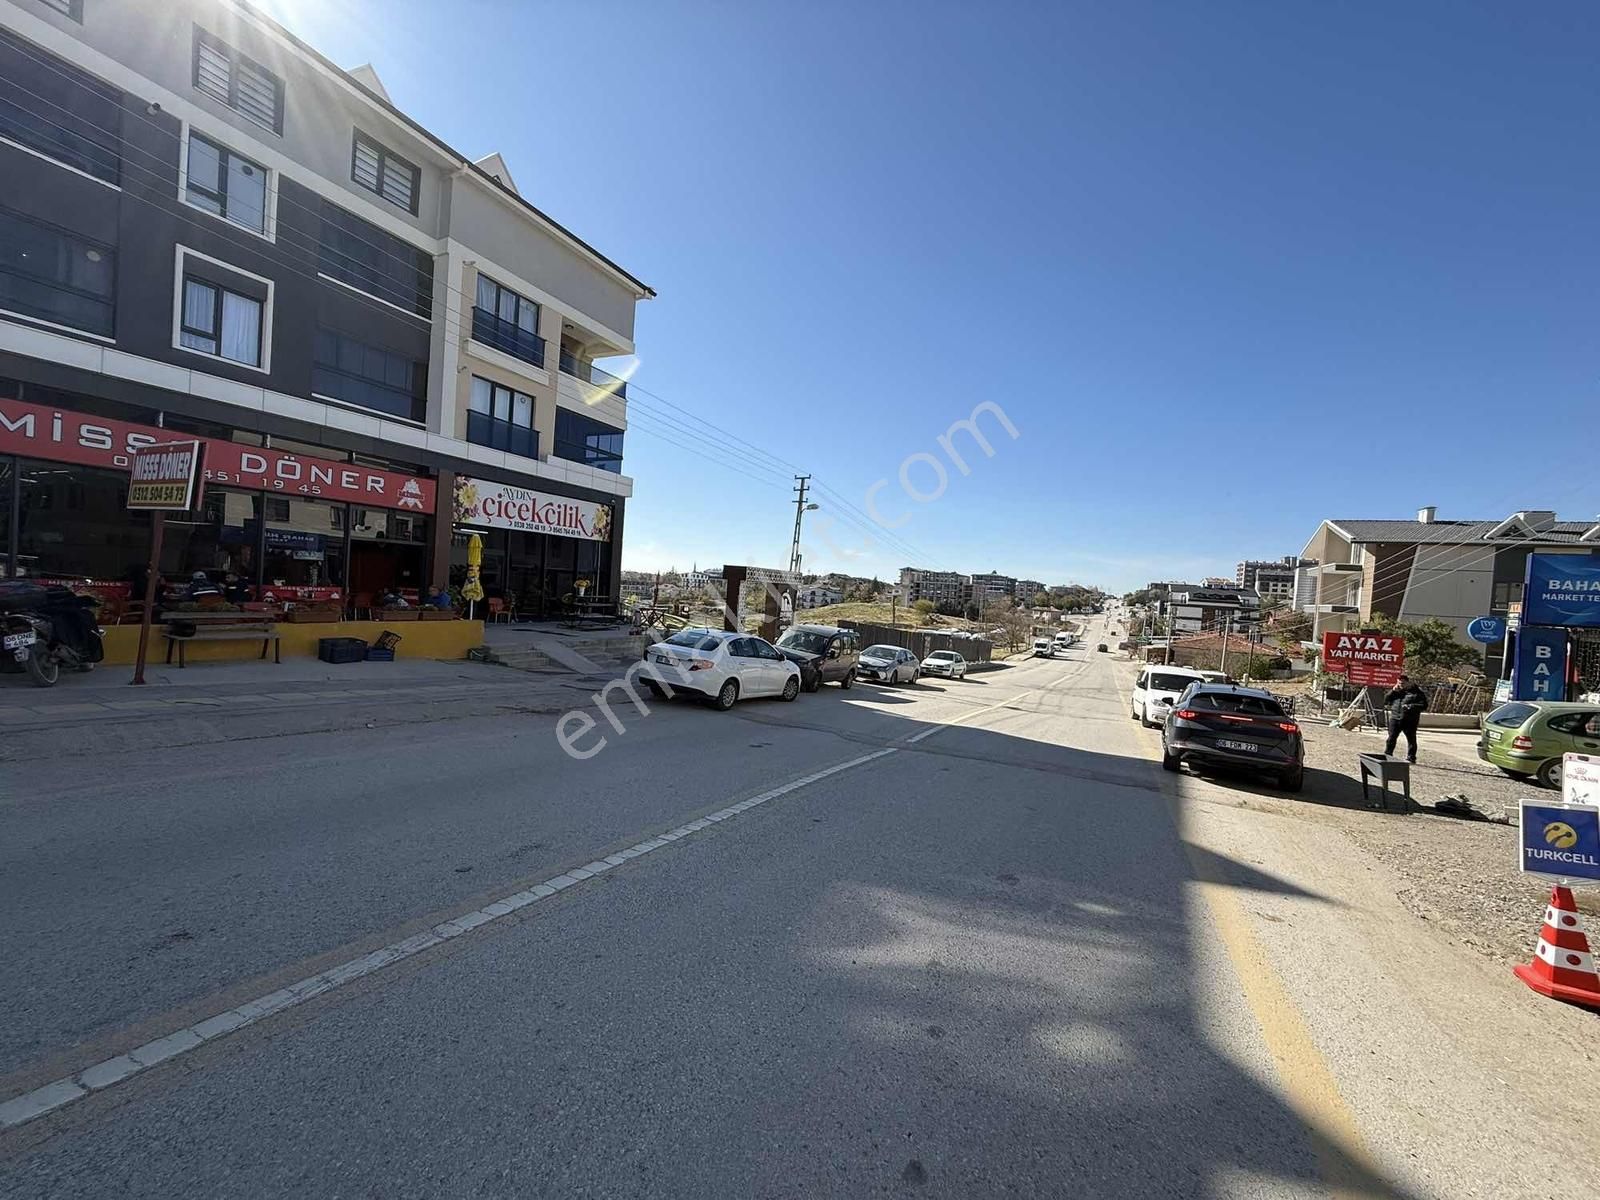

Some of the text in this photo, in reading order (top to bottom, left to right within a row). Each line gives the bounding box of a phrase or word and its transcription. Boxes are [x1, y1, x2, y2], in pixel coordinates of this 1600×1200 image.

[240, 453, 385, 494] DÖNER
[262, 478, 284, 489] 19
[299, 484, 321, 494] 45
[1548, 579, 1600, 591] BAHA
[1542, 593, 1585, 602] MARKET
[1337, 636, 1393, 651] AYAZ
[1330, 649, 1399, 662] YAPI MARKET
[1533, 645, 1551, 701] BAH
[1525, 847, 1599, 866] TURKCELL
